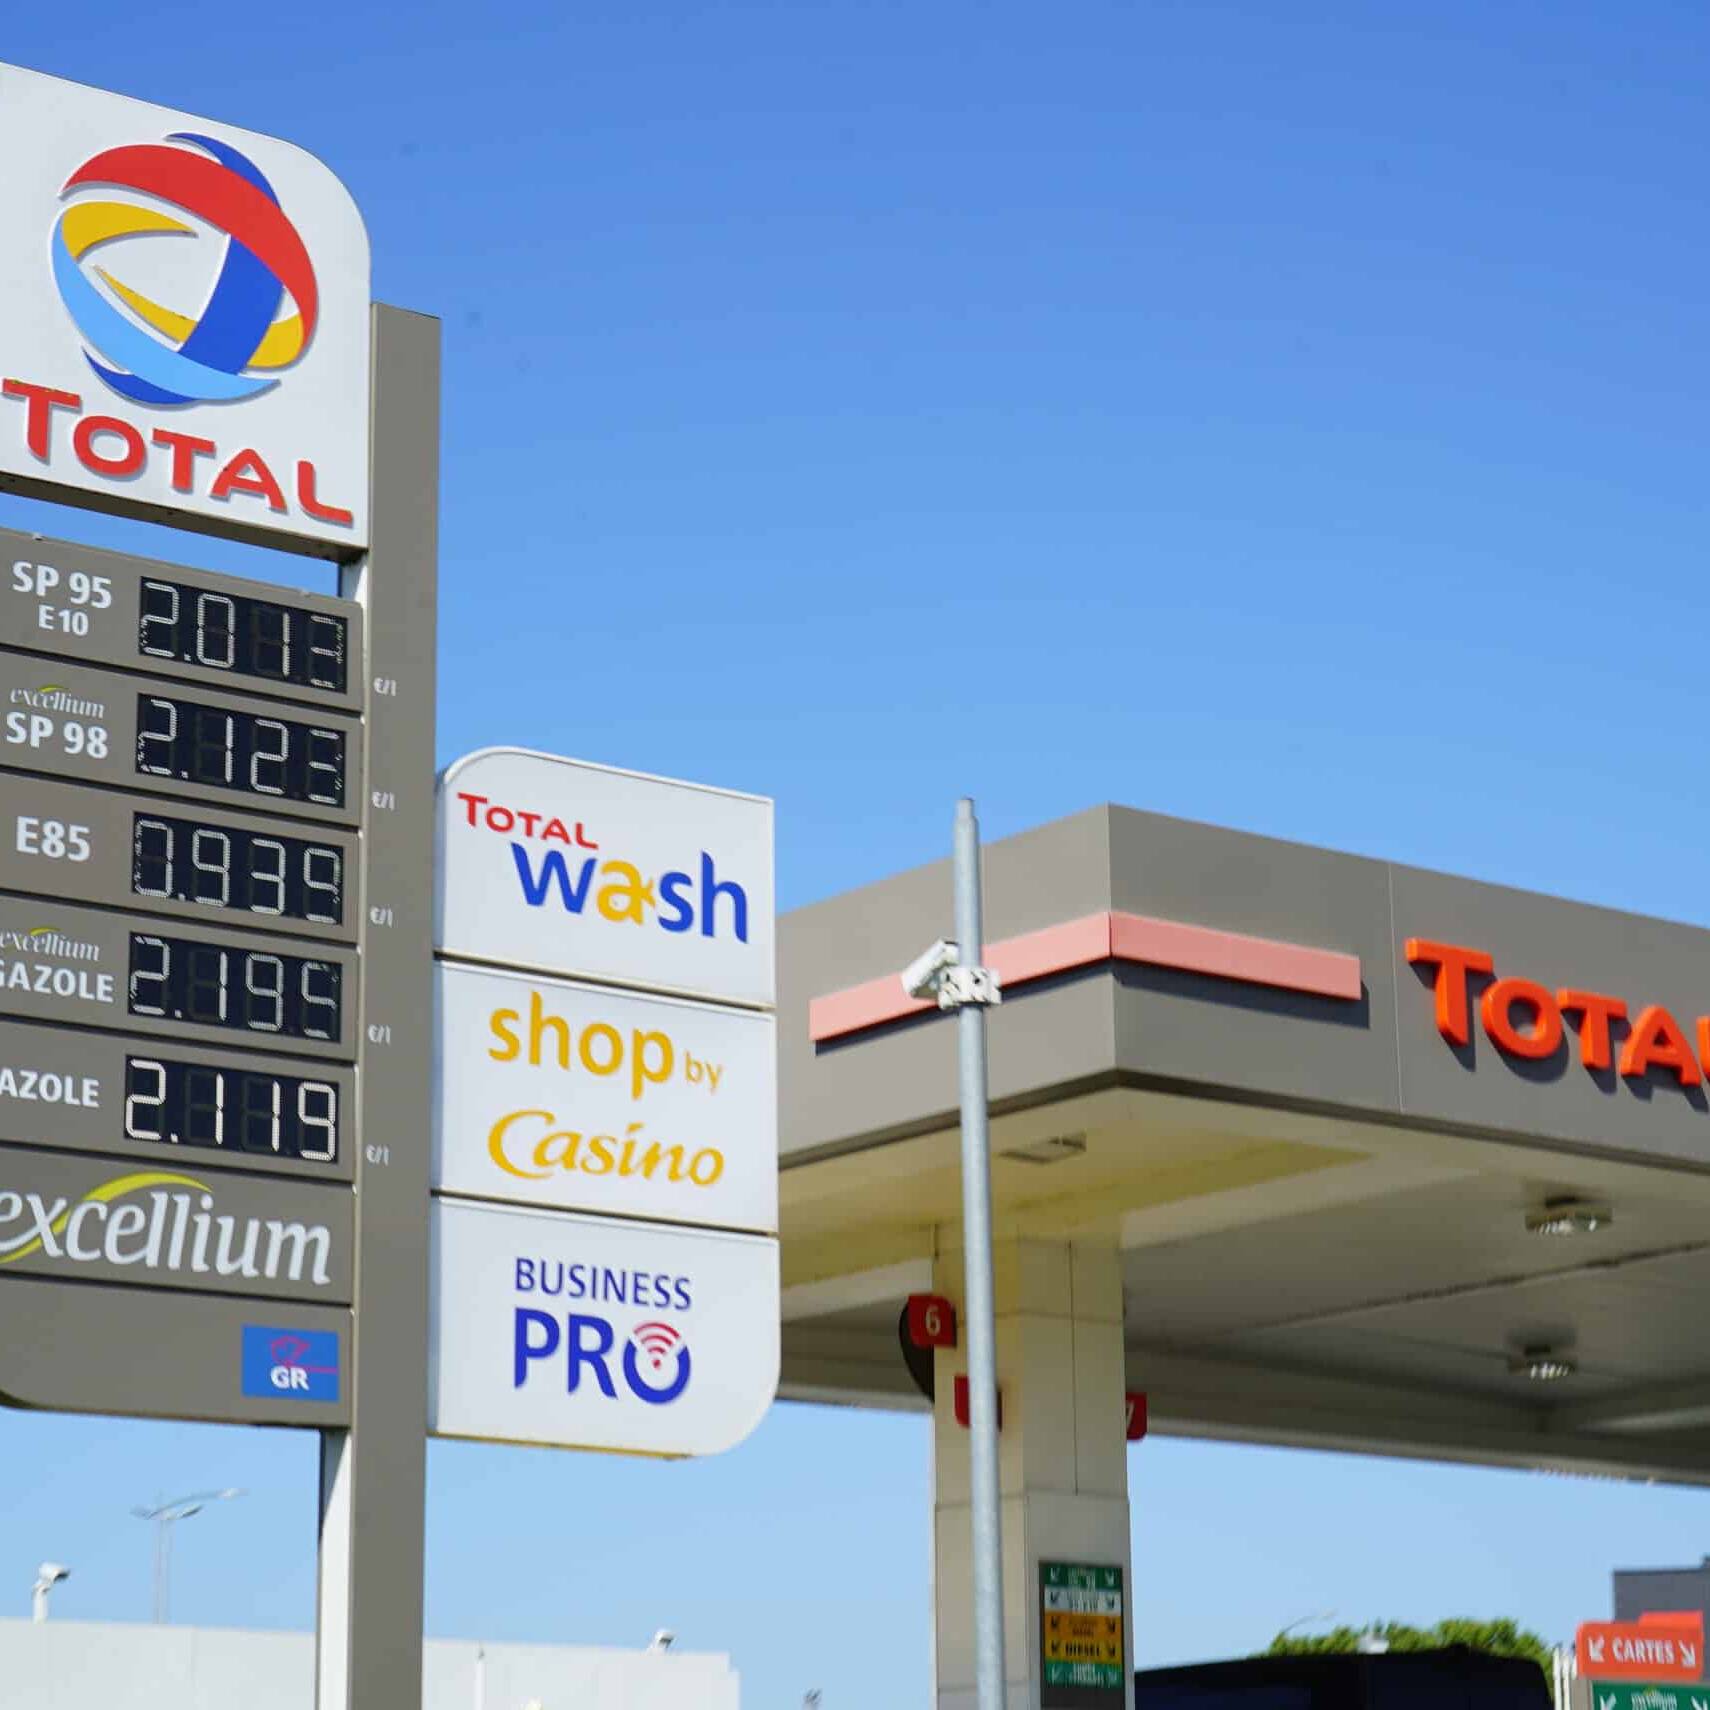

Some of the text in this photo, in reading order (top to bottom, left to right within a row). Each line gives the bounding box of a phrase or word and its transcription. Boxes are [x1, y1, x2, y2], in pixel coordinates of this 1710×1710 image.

[2, 378, 354, 525] TOTAL
[12, 560, 112, 609] SP 95
[10, 687, 105, 719] excellium
[6, 711, 109, 759] SP 98
[16, 815, 91, 861] E85
[457, 792, 599, 850] TOTAL
[488, 991, 723, 1101] shop by
[126, 1058, 337, 1162] 2.119
[487, 1109, 725, 1186] Casino
[0, 1190, 331, 1285] excellium
[514, 1256, 692, 1312] BUSINESS
[925, 1303, 942, 1339] 6
[270, 1366, 310, 1391] GR
[514, 1307, 691, 1406] PRO
[1611, 1636, 1676, 1665] CARTES
